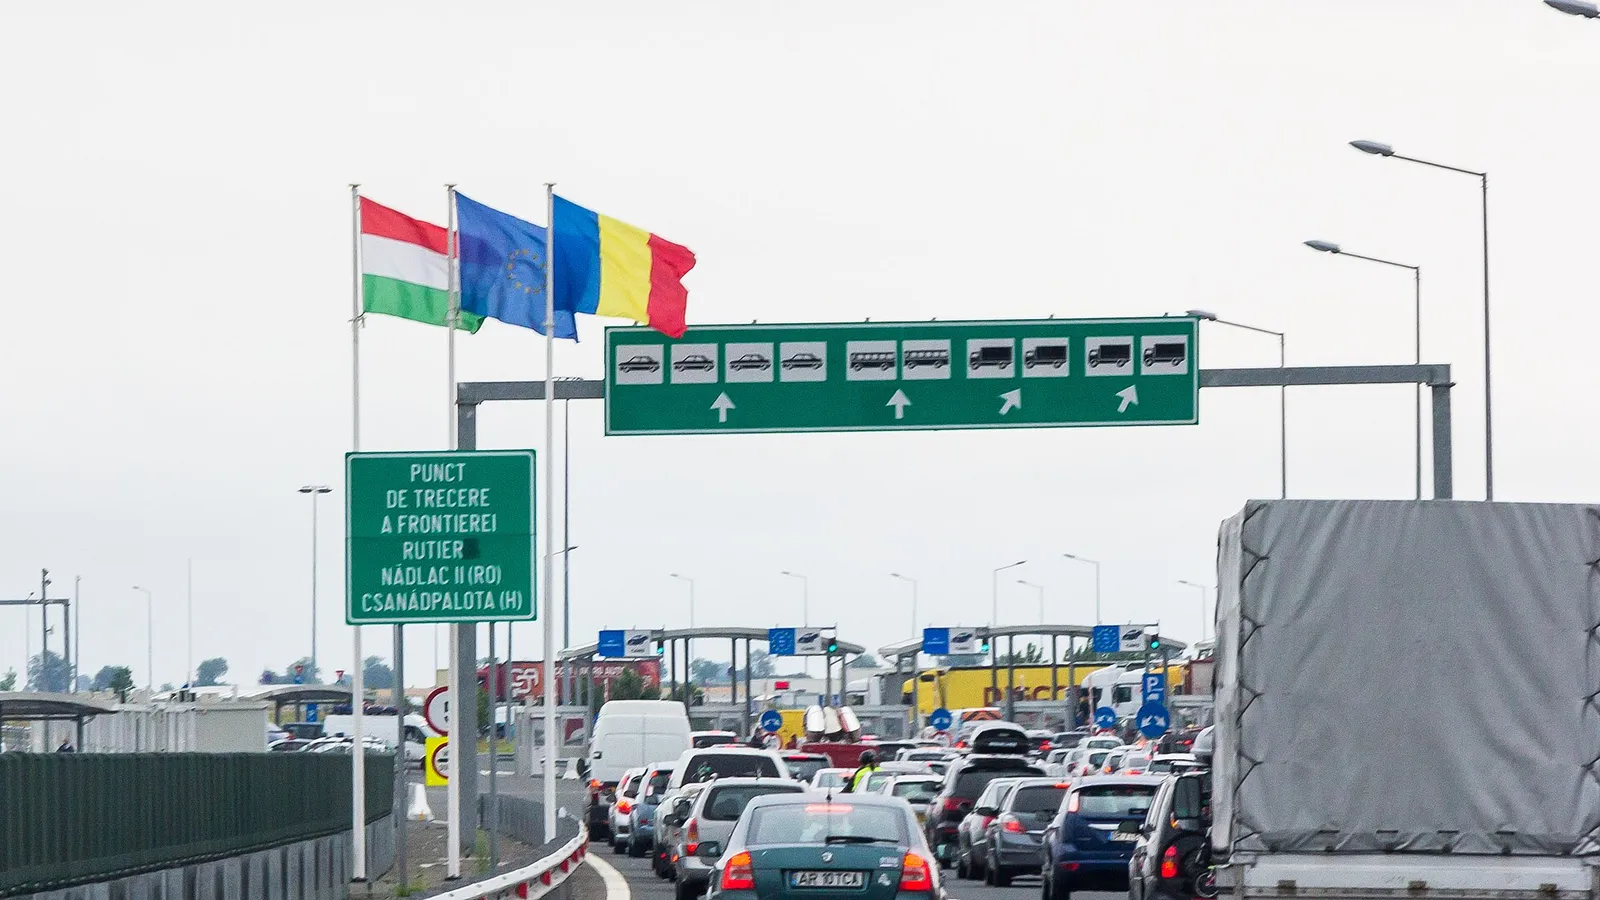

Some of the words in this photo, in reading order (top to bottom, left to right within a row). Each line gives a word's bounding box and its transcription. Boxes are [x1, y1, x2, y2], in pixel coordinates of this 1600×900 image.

[410, 463, 466, 482] PUNCT
[386, 489, 408, 508] DE
[414, 488, 491, 508] TRECERE
[381, 515, 392, 534] A
[398, 513, 497, 533] FRONTIEREI
[403, 540, 464, 560] RUTIER
[467, 565, 502, 585] (RO)
[362, 589, 495, 612] CSANÁDPALOTA
[499, 590, 524, 609] (H)
